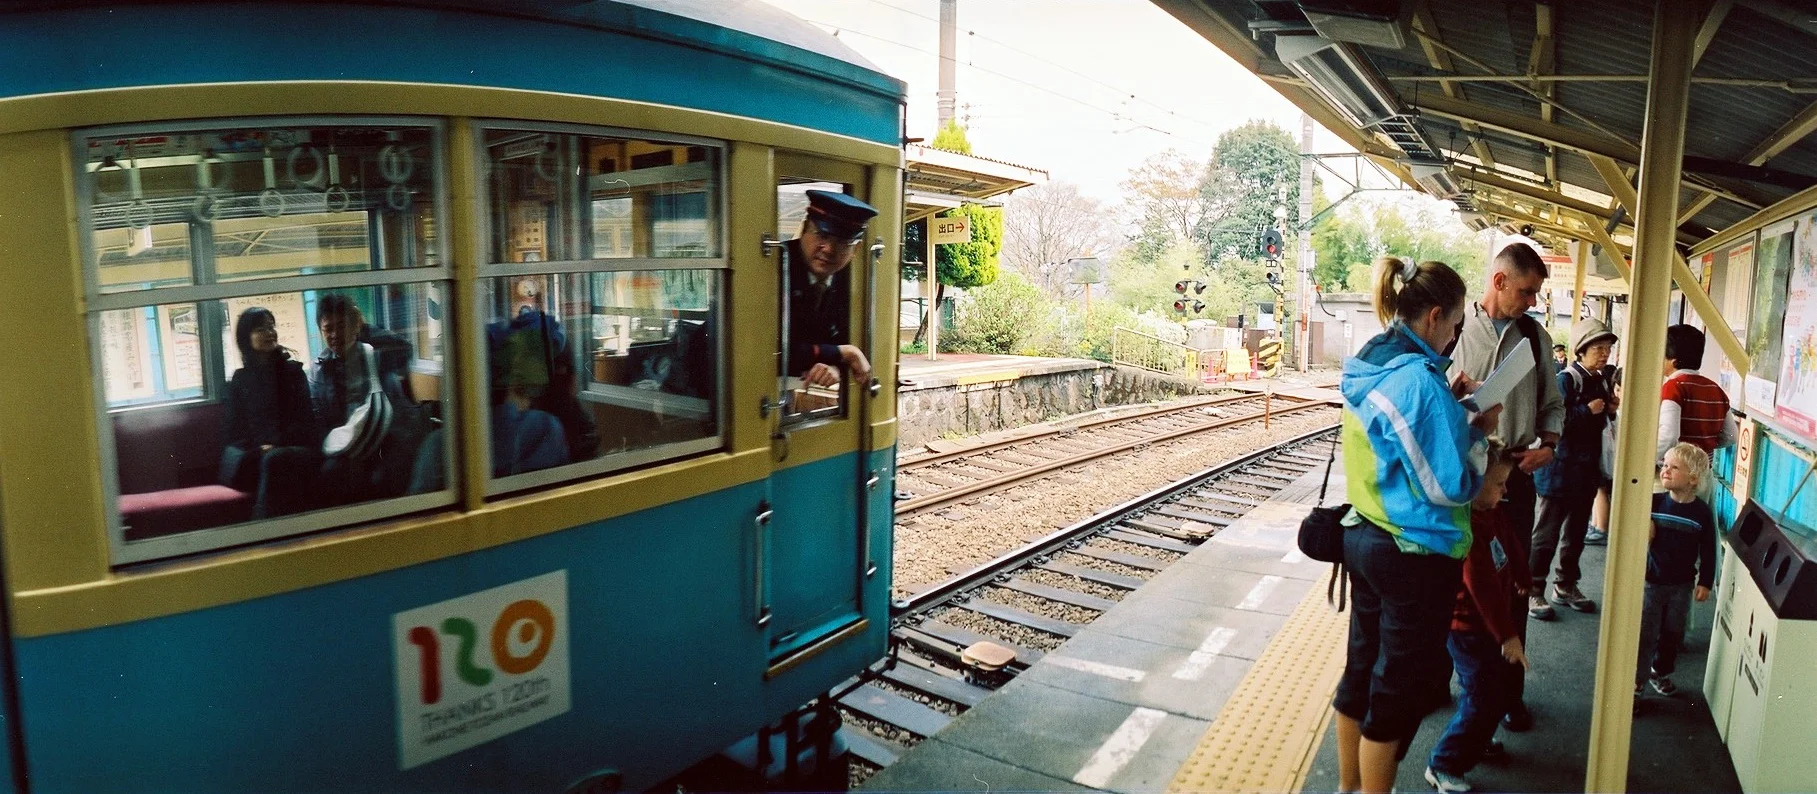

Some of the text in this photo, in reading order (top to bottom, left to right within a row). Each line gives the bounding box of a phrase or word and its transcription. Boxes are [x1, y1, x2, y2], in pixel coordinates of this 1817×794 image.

[939, 223, 954, 233] 出口
[408, 599, 556, 705] 120
[420, 691, 497, 732] THANKS
